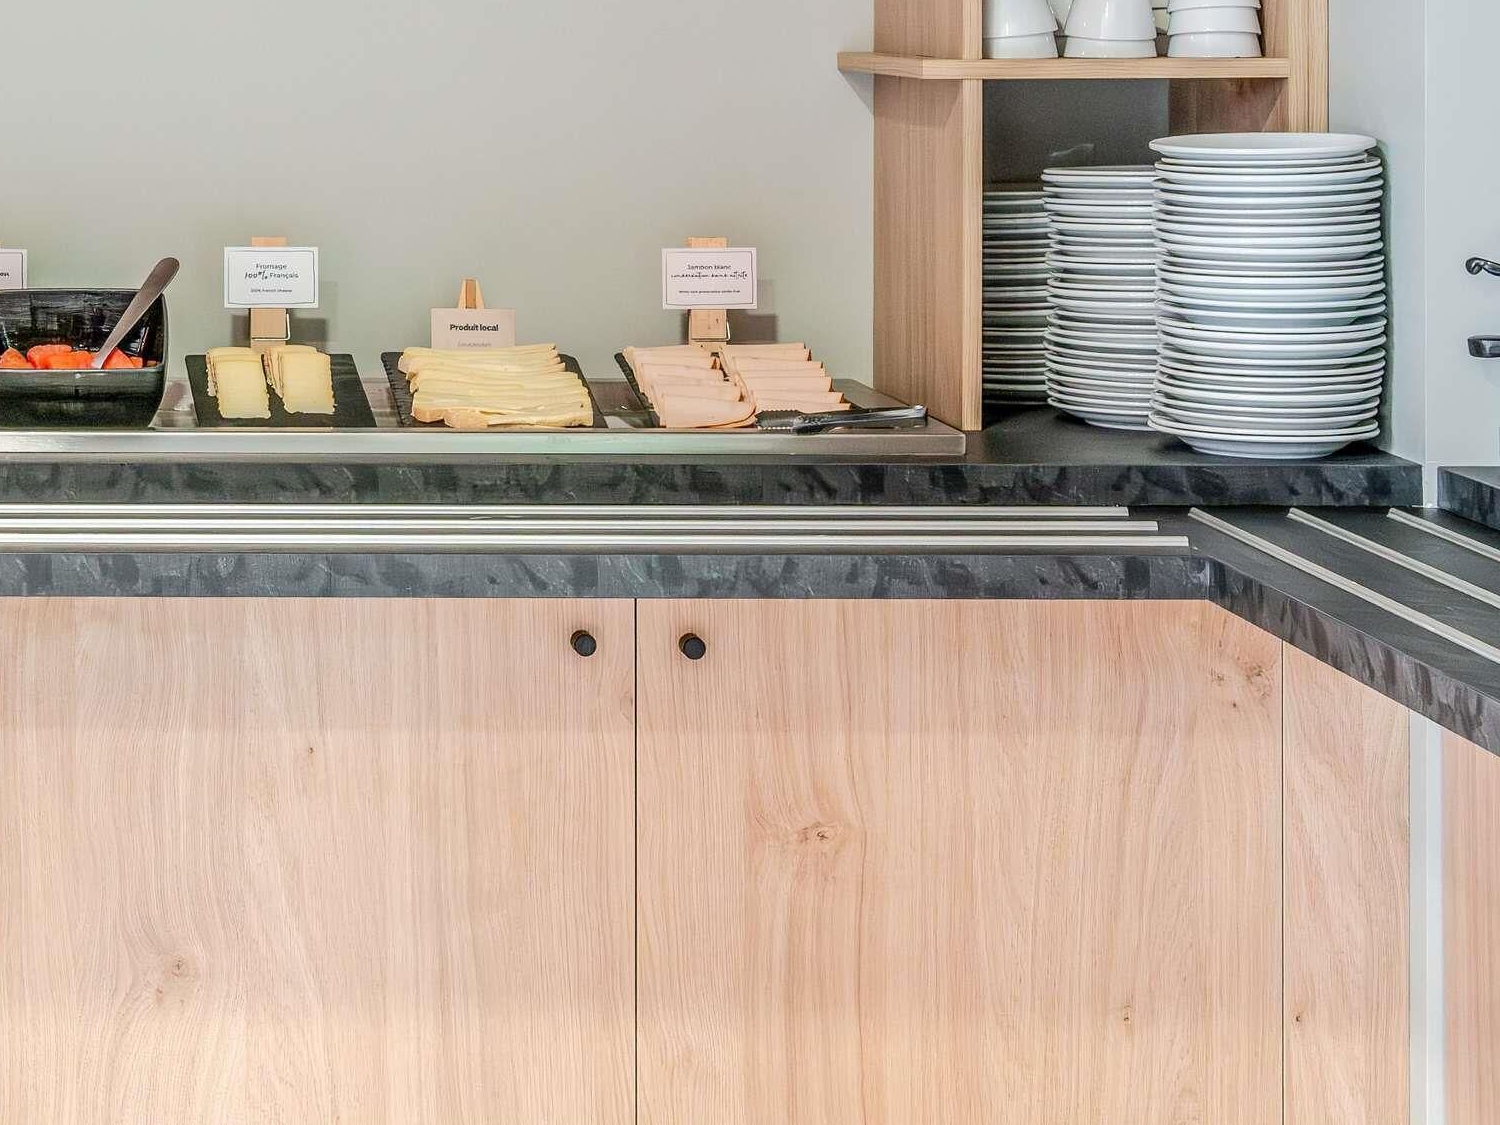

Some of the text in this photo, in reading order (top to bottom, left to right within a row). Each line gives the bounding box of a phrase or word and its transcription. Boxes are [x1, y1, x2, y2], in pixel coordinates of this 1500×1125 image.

[269, 272, 299, 280] Français
[449, 323, 499, 332] Produit local
